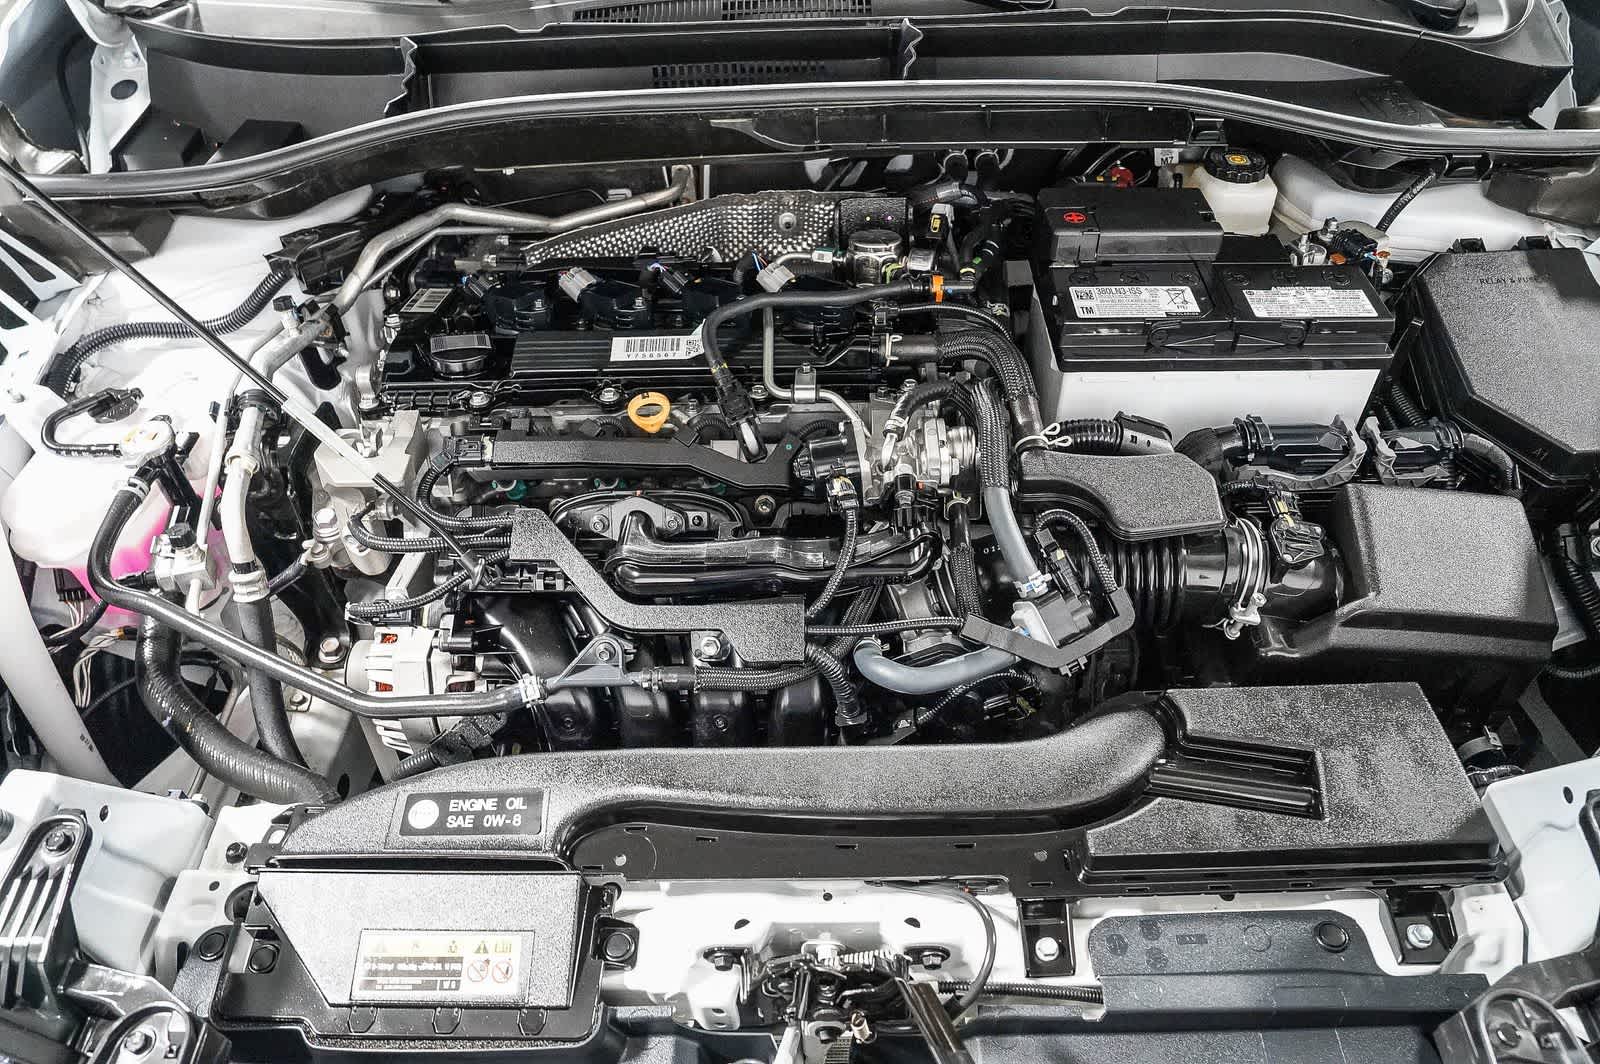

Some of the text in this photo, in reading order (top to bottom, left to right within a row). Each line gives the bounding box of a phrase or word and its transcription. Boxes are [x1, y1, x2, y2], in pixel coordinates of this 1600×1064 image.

[1079, 306, 1095, 315] TM
[449, 798, 498, 812] ENGINE
[505, 797, 528, 810] OIL
[446, 814, 522, 829] SAE 0W-8
